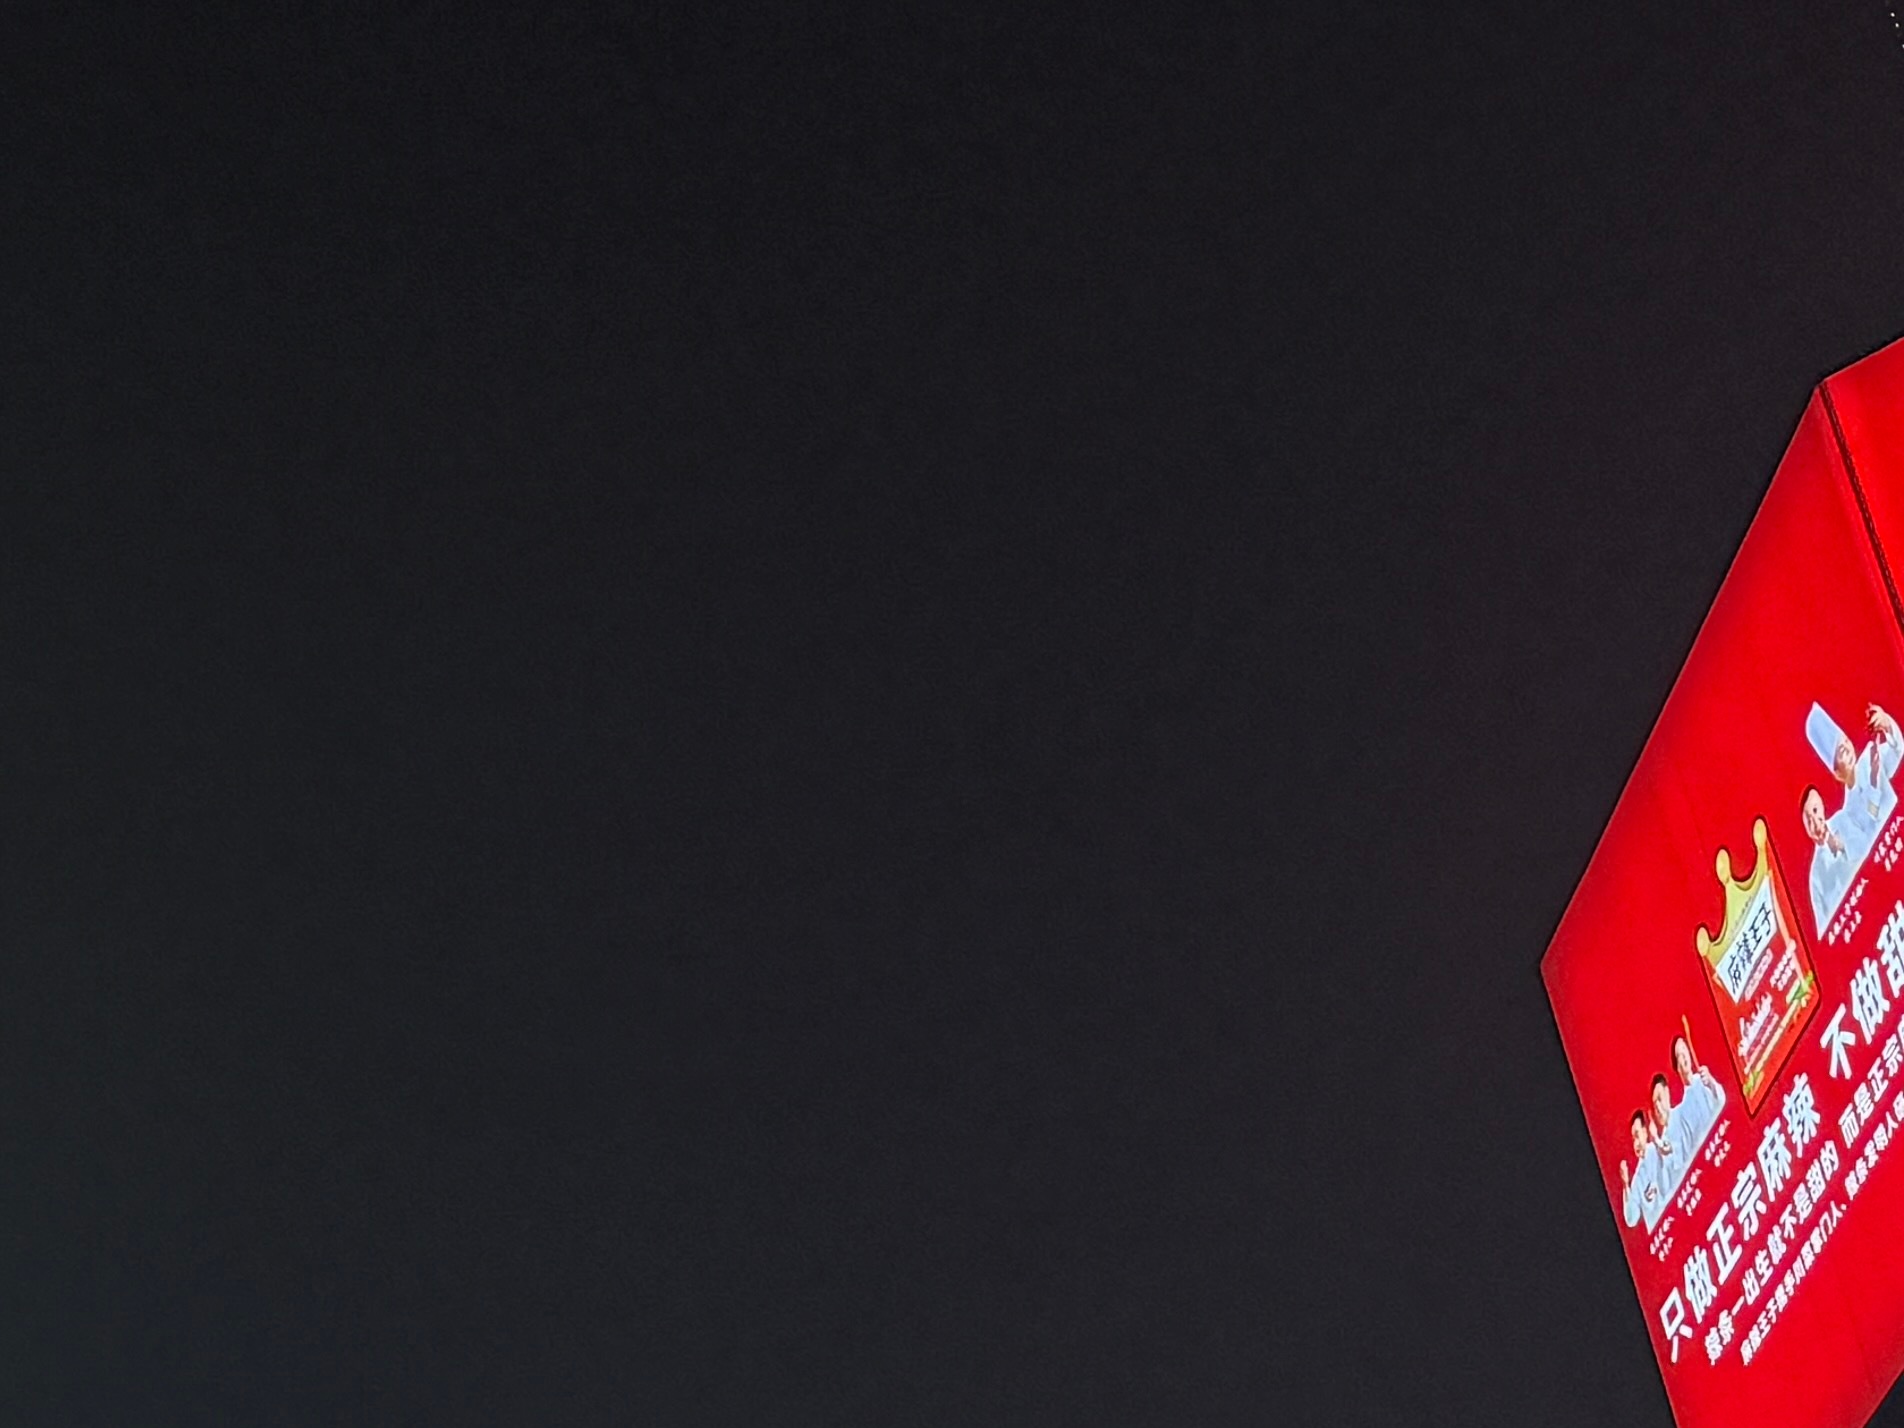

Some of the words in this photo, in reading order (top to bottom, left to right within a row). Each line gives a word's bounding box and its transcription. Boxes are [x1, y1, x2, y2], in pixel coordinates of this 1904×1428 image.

[1838, 1012, 1904, 1149] 而是正宗
[1659, 1072, 1821, 1364] 只做正宗麻辣
